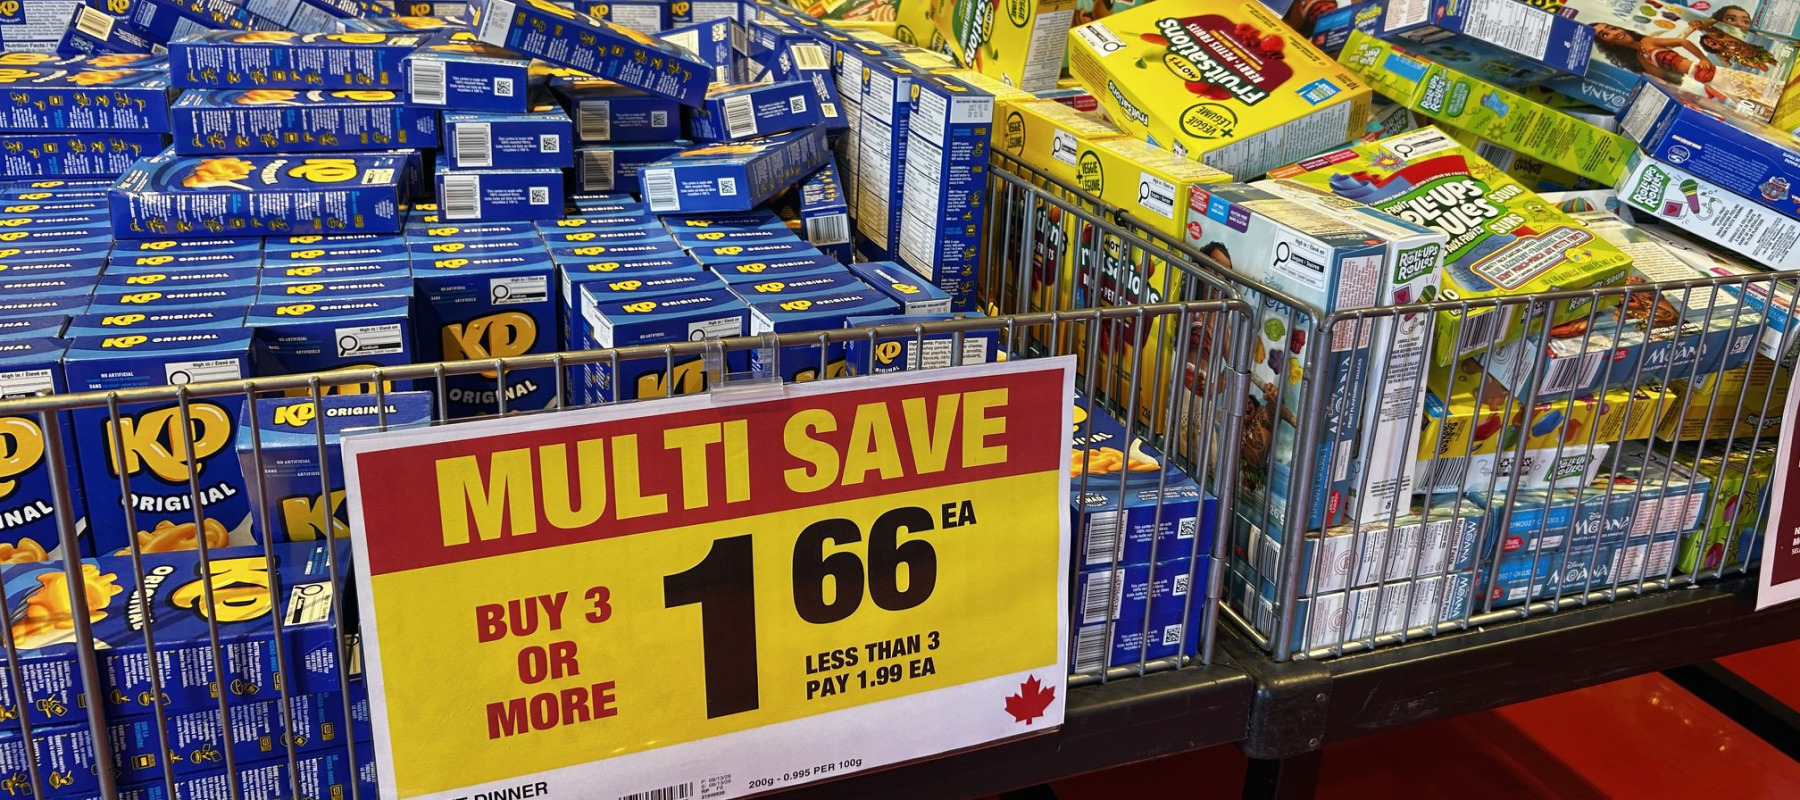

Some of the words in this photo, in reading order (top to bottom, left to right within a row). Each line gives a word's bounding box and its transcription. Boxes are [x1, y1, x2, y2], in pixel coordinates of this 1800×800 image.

[410, 4, 430, 16] KP
[590, 4, 609, 18] KP
[672, 2, 690, 15] KP
[1186, 23, 1214, 44] FRUITS
[1209, 41, 1238, 63] PETITS
[1159, 18, 1268, 104] Fruitsations
[1007, 119, 1022, 133] VEGGIE
[1185, 115, 1217, 137] VEGGIE
[1082, 161, 1098, 175] VEGGIE
[1633, 166, 1657, 204] ROLL-UPS
[1489, 184, 1524, 203] SOUR
[4, 205, 40, 213] KP
[1384, 201, 1411, 216] FRUIT
[0, 218, 32, 227] KP
[557, 218, 587, 227] KP
[685, 219, 714, 228] KP
[1490, 213, 1525, 235] SURS
[0, 232, 29, 241] KP
[428, 227, 460, 236] KP
[565, 232, 596, 241] KP
[696, 232, 726, 240] KP
[1461, 227, 1485, 246] FRUITS
[140, 240, 177, 250] KP
[289, 236, 324, 244] KP
[432, 242, 466, 252] KP
[24, 247, 82, 255] ORIGINAL
[290, 250, 326, 259] KP
[573, 246, 606, 256] KP
[714, 246, 744, 256] KP
[747, 244, 792, 252] ORIGINAL
[1400, 245, 1439, 263] ROLL-UPS
[136, 256, 174, 265] KP
[434, 258, 469, 269] KP
[587, 262, 620, 272] KP
[736, 262, 768, 274] KP
[770, 260, 816, 268] ORIGINAL
[286, 266, 322, 276] KP
[326, 264, 382, 272] ORIGINAL
[126, 274, 167, 285] KP
[608, 280, 643, 290] KP
[646, 276, 696, 286] ORIGINAL
[754, 281, 786, 293] KP
[788, 278, 834, 288] ORIGINAL
[286, 283, 325, 294] KP
[328, 282, 386, 290] ORIGINAL
[120, 292, 162, 304] KP
[166, 290, 228, 299] ORIGINAL
[779, 300, 813, 311] KP
[816, 295, 864, 306] ORIGINAL
[276, 304, 316, 316] KP
[320, 302, 380, 311] ORIGINAL
[622, 301, 657, 313] KP
[662, 297, 713, 306] ORIGINAL
[101, 313, 146, 326] KP
[150, 312, 214, 321] ORIGINAL
[101, 335, 148, 348] KP
[152, 334, 219, 343] ORIGINAL
[440, 311, 537, 378] KP
[449, 380, 537, 404] ORIGINAL
[274, 403, 316, 427] KP
[107, 404, 230, 482] KP
[435, 419, 751, 548] MULTI
[783, 387, 1009, 493] SAVE
[1453, 520, 1464, 546] Nutrition
[1460, 521, 1477, 563] MOANA
[1444, 576, 1456, 602] Nutrition
[1452, 576, 1468, 617] MOANA
[475, 591, 569, 643] BUY
[584, 586, 612, 624] 3
[663, 534, 759, 720] 1
[792, 506, 938, 625] 66
[941, 500, 977, 529] EA
[805, 647, 858, 675] LESS
[865, 634, 921, 662] THAN
[927, 631, 940, 651] 3
[517, 640, 580, 685] OR
[806, 673, 850, 700] PAY
[857, 663, 903, 690] 1.99
[909, 657, 936, 680] EA
[486, 680, 618, 740] MORE
[749, 777, 774, 789] 200g
[783, 767, 811, 782] 0.995
[814, 763, 835, 775] PER
[838, 758, 863, 771] 100g
